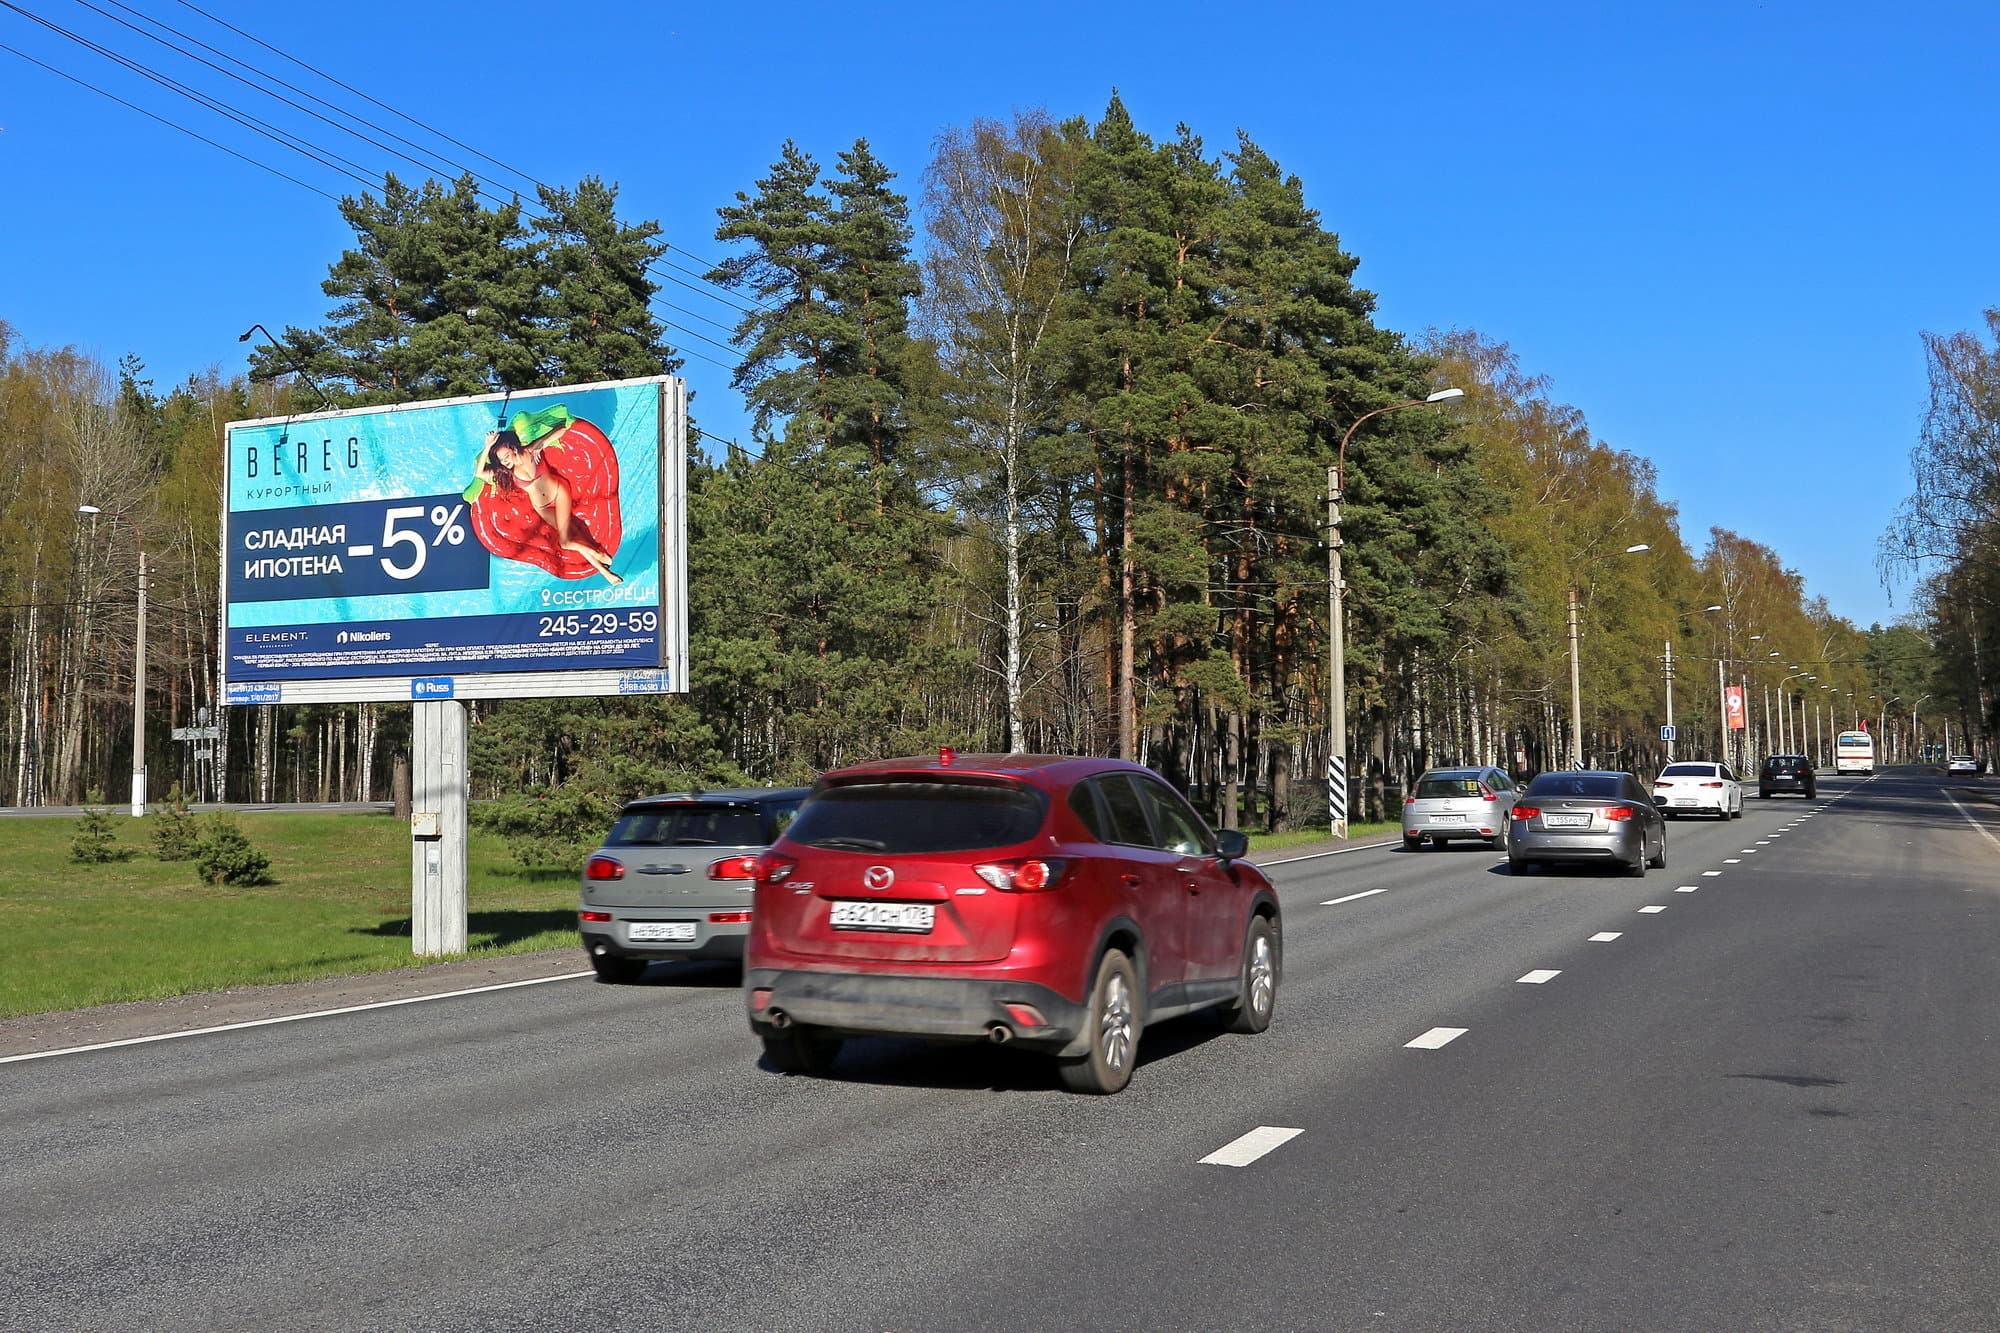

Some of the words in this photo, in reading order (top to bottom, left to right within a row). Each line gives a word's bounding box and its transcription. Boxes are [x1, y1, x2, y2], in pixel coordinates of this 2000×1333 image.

[246, 437, 359, 478] BEREG
[246, 481, 332, 500] КУРОРТНЫЙ
[244, 524, 346, 551] СЛАДКАЯ
[244, 554, 343, 580] ИПОТЕКА
[552, 585, 657, 605] СЕСТРОРЕЦК
[538, 611, 658, 637] 245-29-59
[349, 631, 392, 643] Nikoliers
[427, 682, 450, 693] Russ
